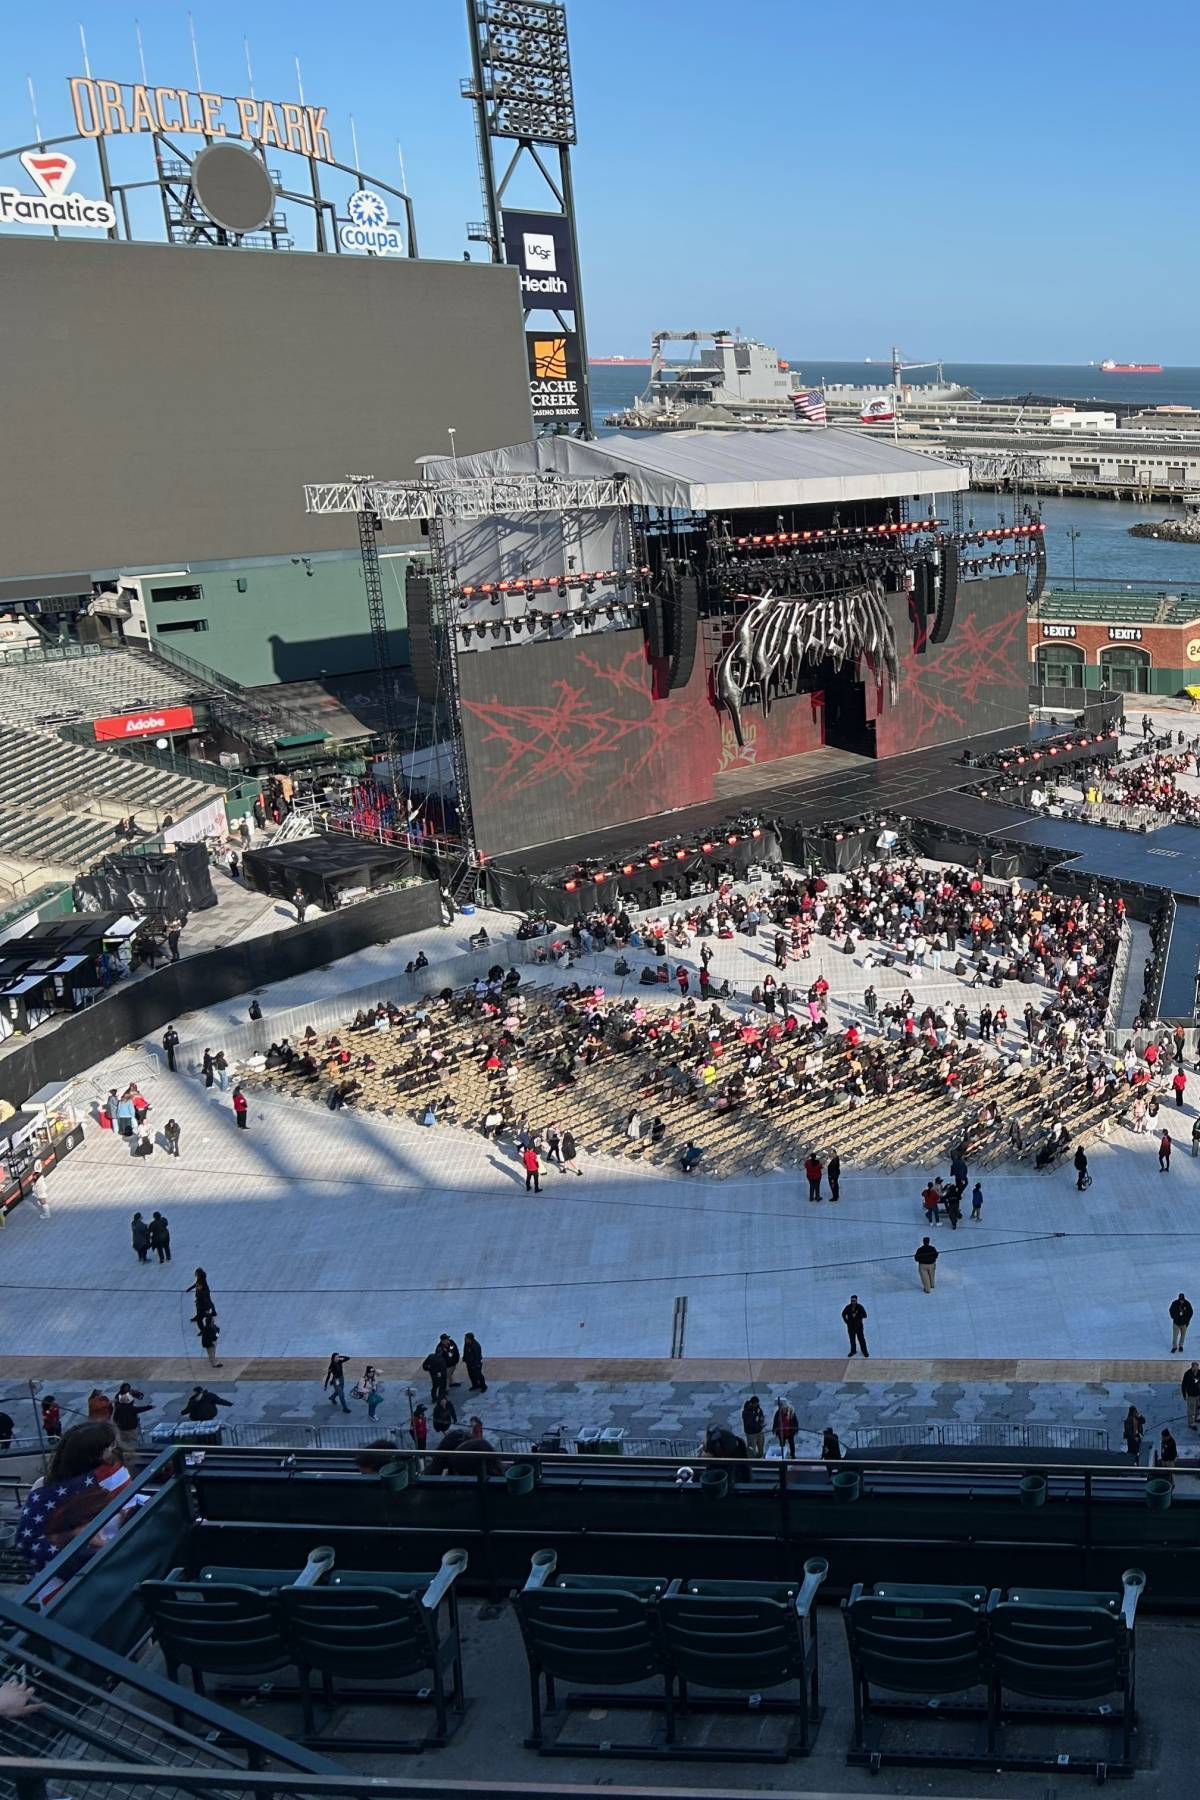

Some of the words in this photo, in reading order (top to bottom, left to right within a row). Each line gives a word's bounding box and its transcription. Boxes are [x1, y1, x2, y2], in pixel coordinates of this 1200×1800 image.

[70, 77, 226, 138] ORACLE
[235, 97, 336, 164] PARK
[0, 192, 110, 222] Fanatics
[345, 229, 399, 252] coupa
[528, 245, 552, 260] UCSF
[519, 275, 568, 293] Health
[529, 380, 578, 393] CACHE
[530, 394, 578, 406] CREEK
[1049, 625, 1071, 637] EXIT
[1114, 629, 1136, 639] EXIT
[126, 717, 166, 732] Adobe
